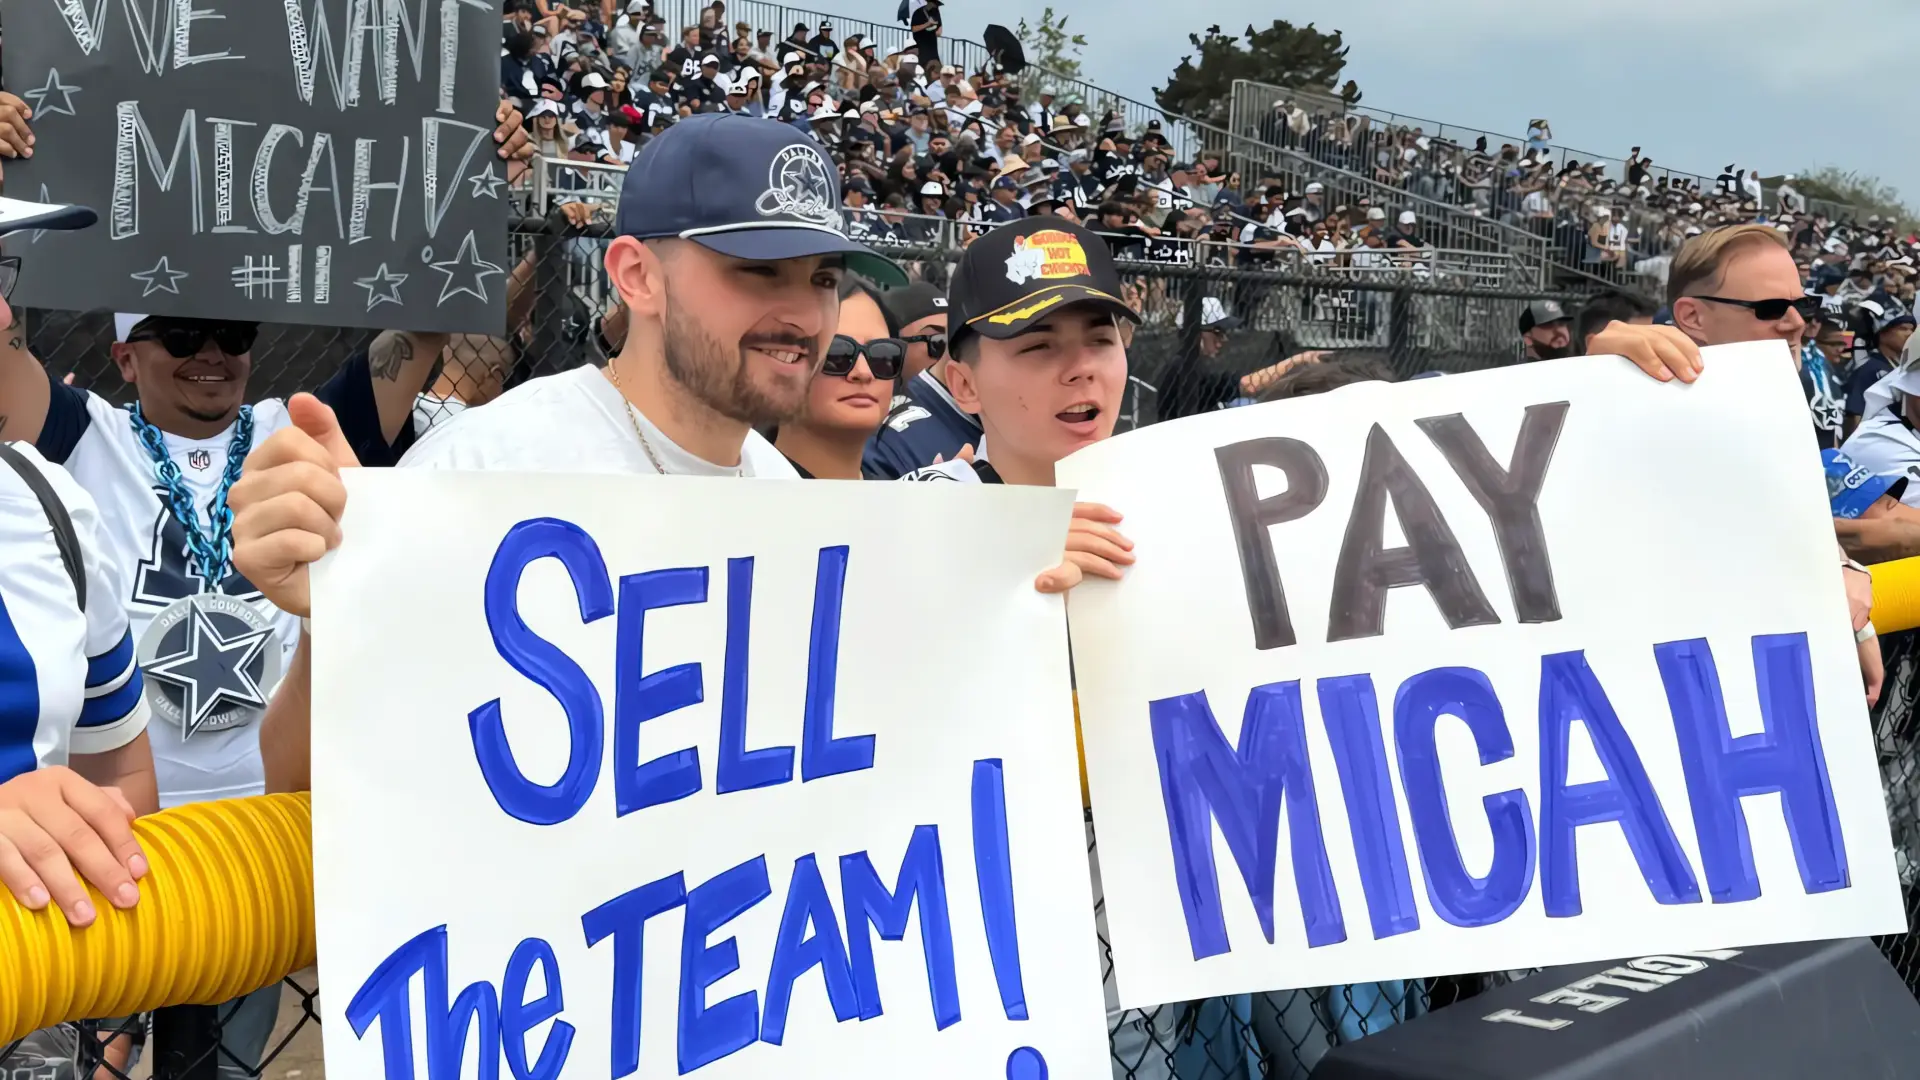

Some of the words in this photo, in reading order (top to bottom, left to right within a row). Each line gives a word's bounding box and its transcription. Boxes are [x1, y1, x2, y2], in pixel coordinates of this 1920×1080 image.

[55, 0, 246, 77] WE
[284, 0, 494, 114] WANT
[110, 100, 490, 264] MICAH!
[231, 243, 332, 303] #11
[1213, 400, 1571, 650] PAY
[468, 516, 877, 826] SELL
[344, 924, 577, 1080] The
[581, 756, 1049, 1080] TEAM!
[1148, 631, 1853, 962] MICAH
